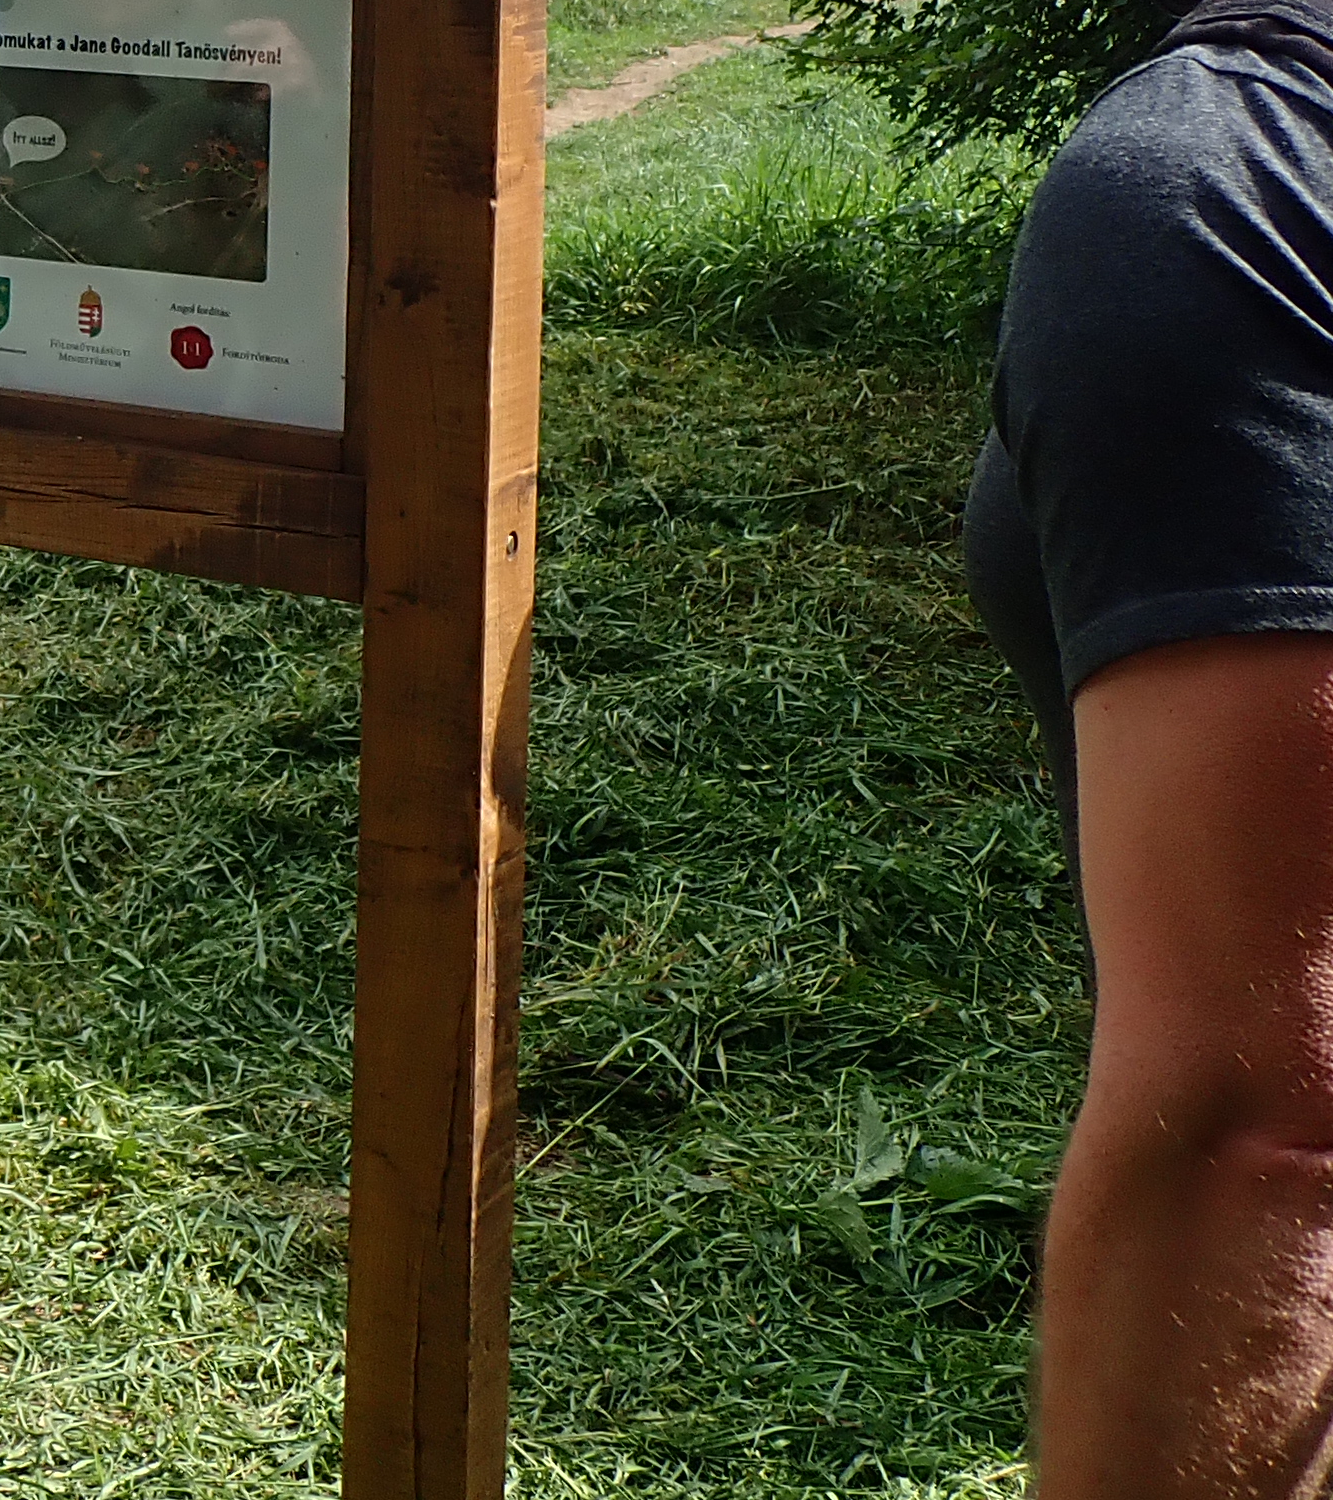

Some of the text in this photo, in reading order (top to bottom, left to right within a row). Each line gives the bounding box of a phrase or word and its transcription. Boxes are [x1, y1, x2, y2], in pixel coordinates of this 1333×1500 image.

[57, 38, 66, 51] a
[70, 36, 107, 53] Jane
[111, 39, 170, 58] Goodall
[176, 42, 282, 65] Tanösvényen!
[170, 303, 195, 315] Angol
